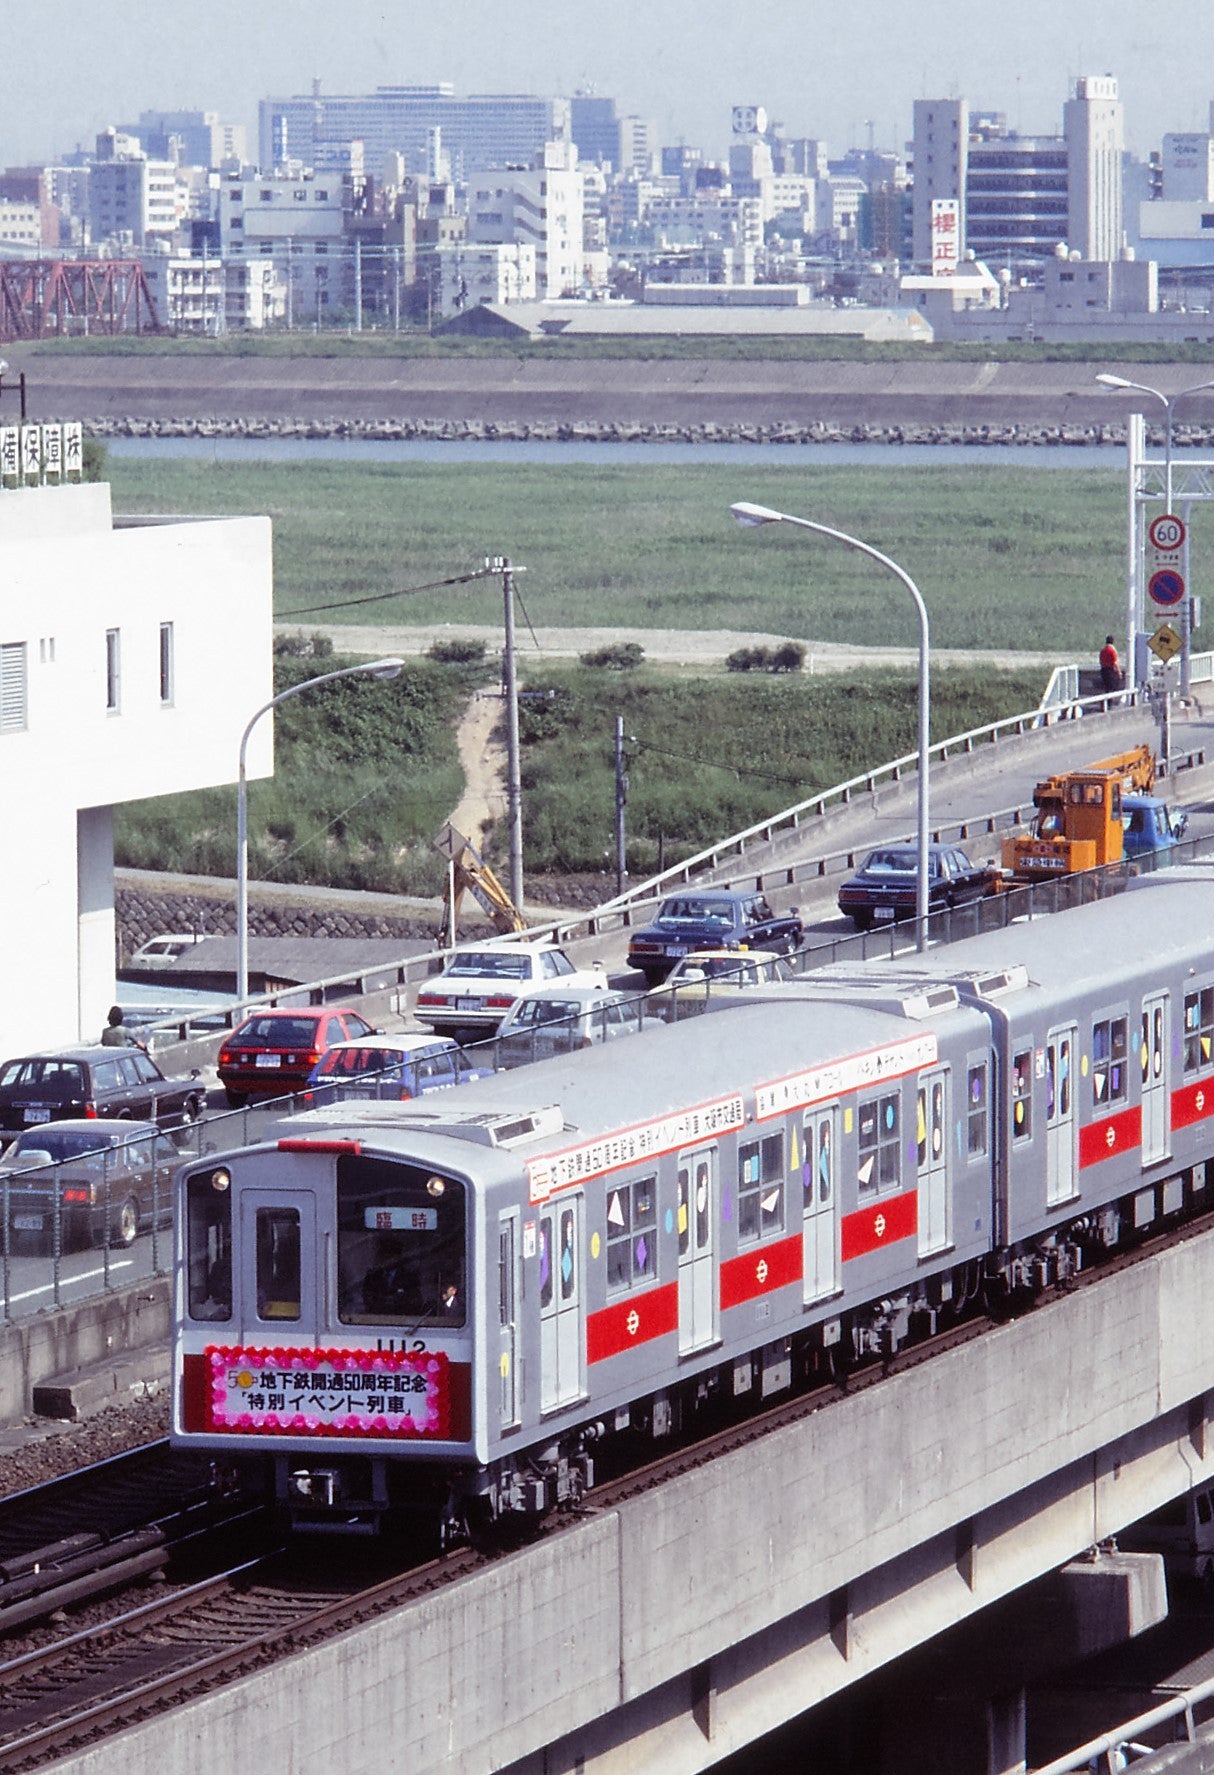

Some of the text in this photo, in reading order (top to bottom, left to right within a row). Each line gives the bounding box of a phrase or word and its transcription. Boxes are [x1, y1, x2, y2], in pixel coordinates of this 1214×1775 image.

[1157, 525, 1178, 542] 60
[259, 1371, 428, 1393] 地下鉄開通50周年記念
